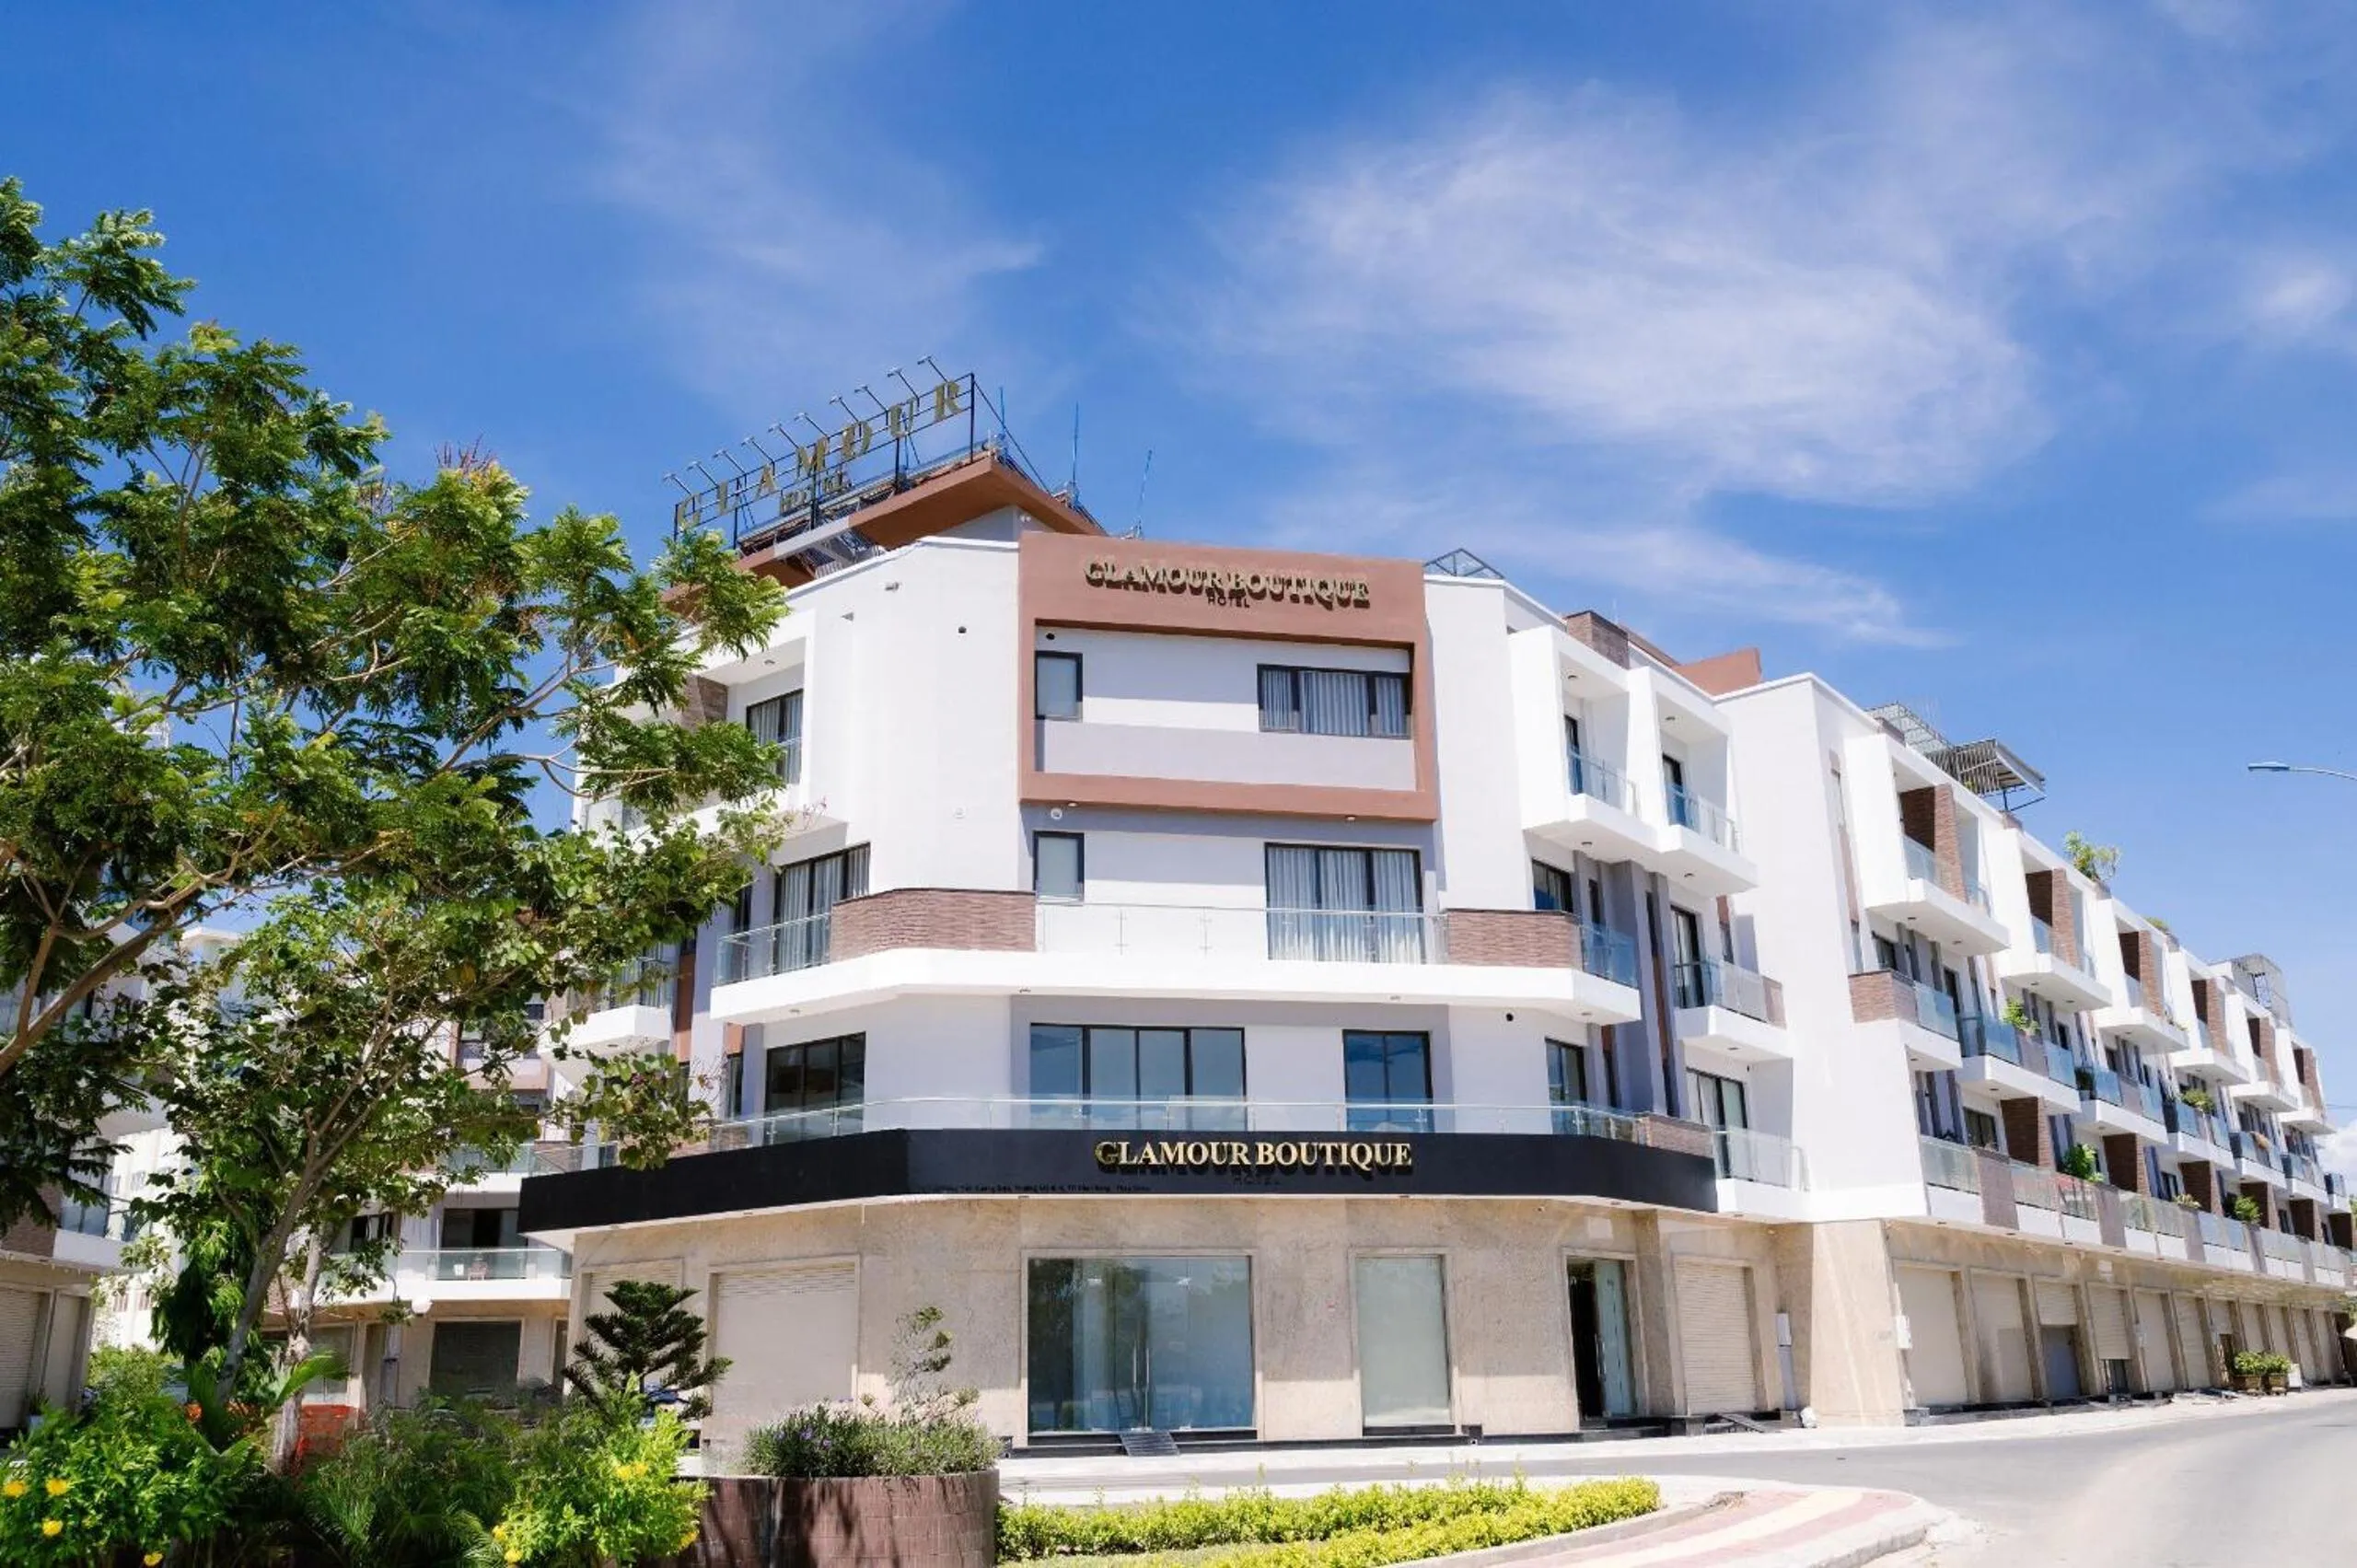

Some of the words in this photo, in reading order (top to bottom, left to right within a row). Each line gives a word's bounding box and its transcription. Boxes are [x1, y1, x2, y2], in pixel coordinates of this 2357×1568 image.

[1085, 556, 1225, 594] GLAMOUR
[1227, 567, 1370, 606] BOUTIQUE
[1208, 596, 1250, 609] HOTEL
[1095, 1141, 1252, 1166] GLAMOUR
[1255, 1142, 1412, 1172] BOUTIQUE
